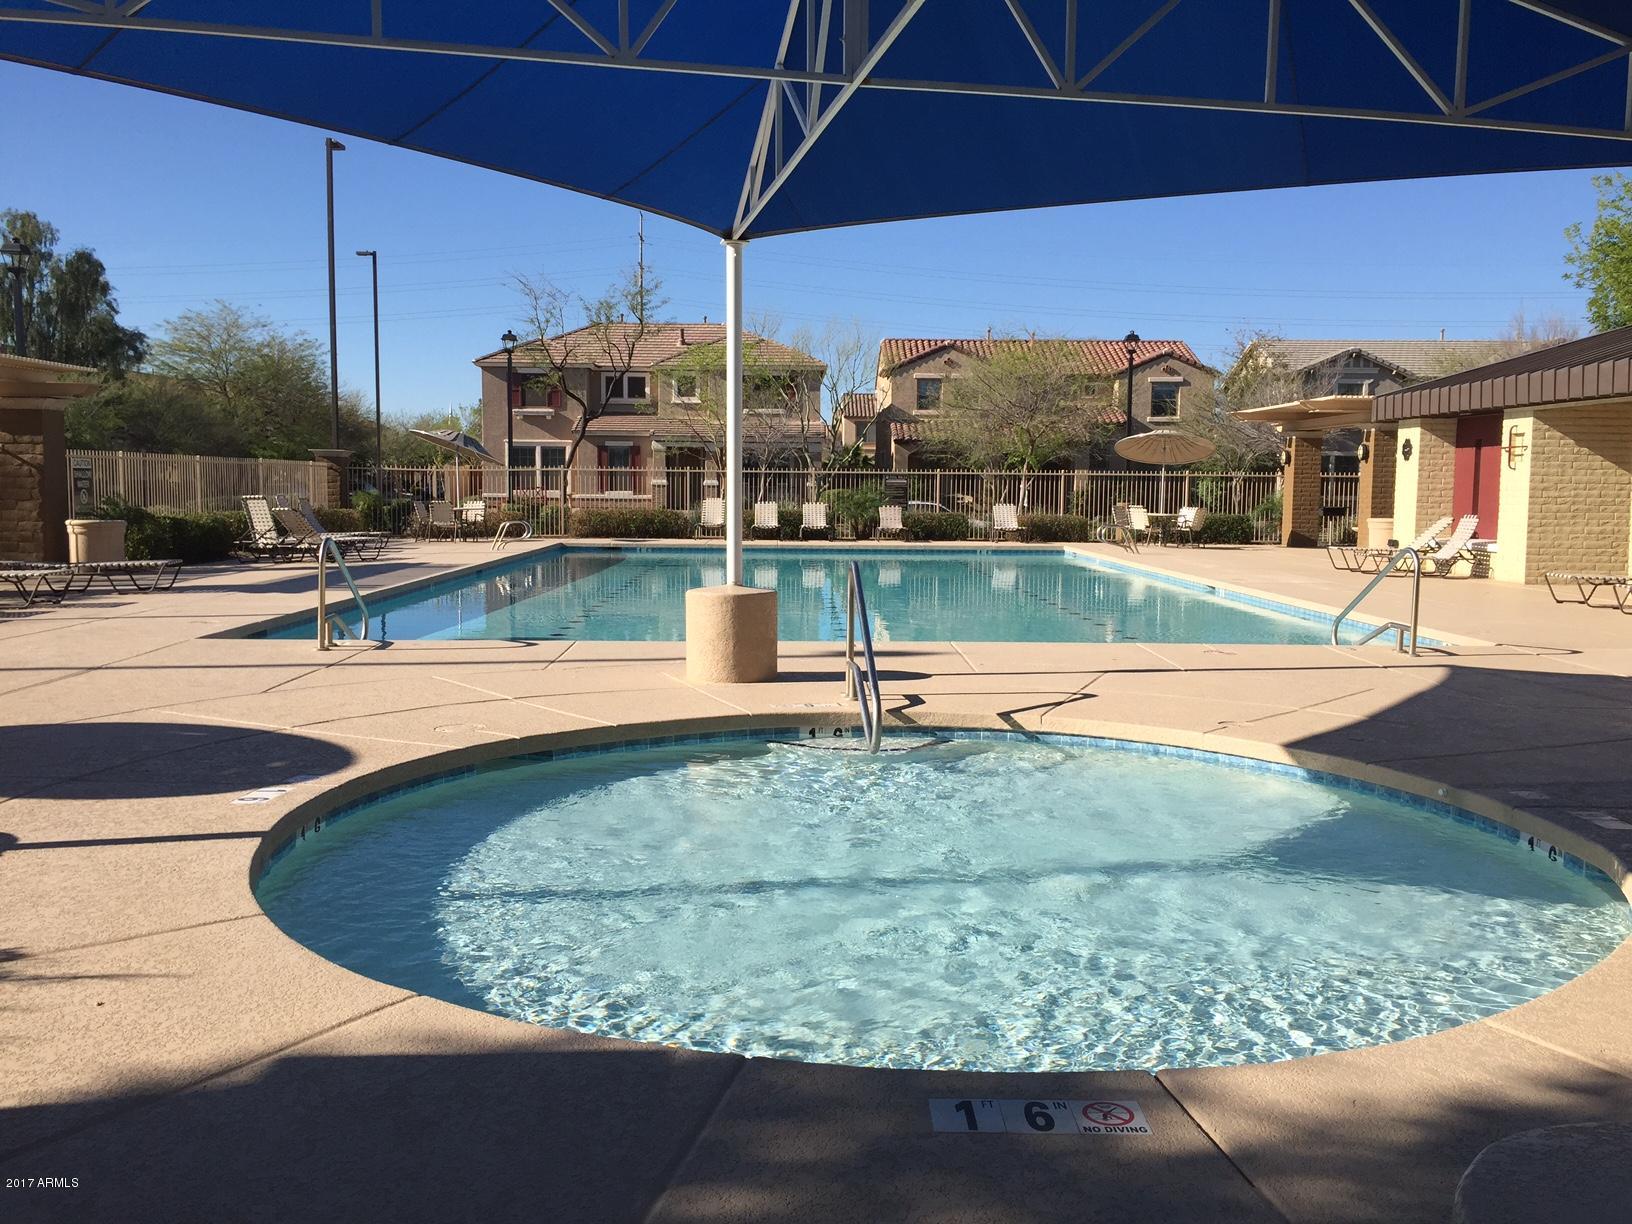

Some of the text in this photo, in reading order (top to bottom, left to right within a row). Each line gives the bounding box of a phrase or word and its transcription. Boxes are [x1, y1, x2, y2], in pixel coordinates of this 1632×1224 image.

[955, 1100, 1067, 1132] 1 FT 6 IN
[1104, 1126, 1148, 1134] DIVING
